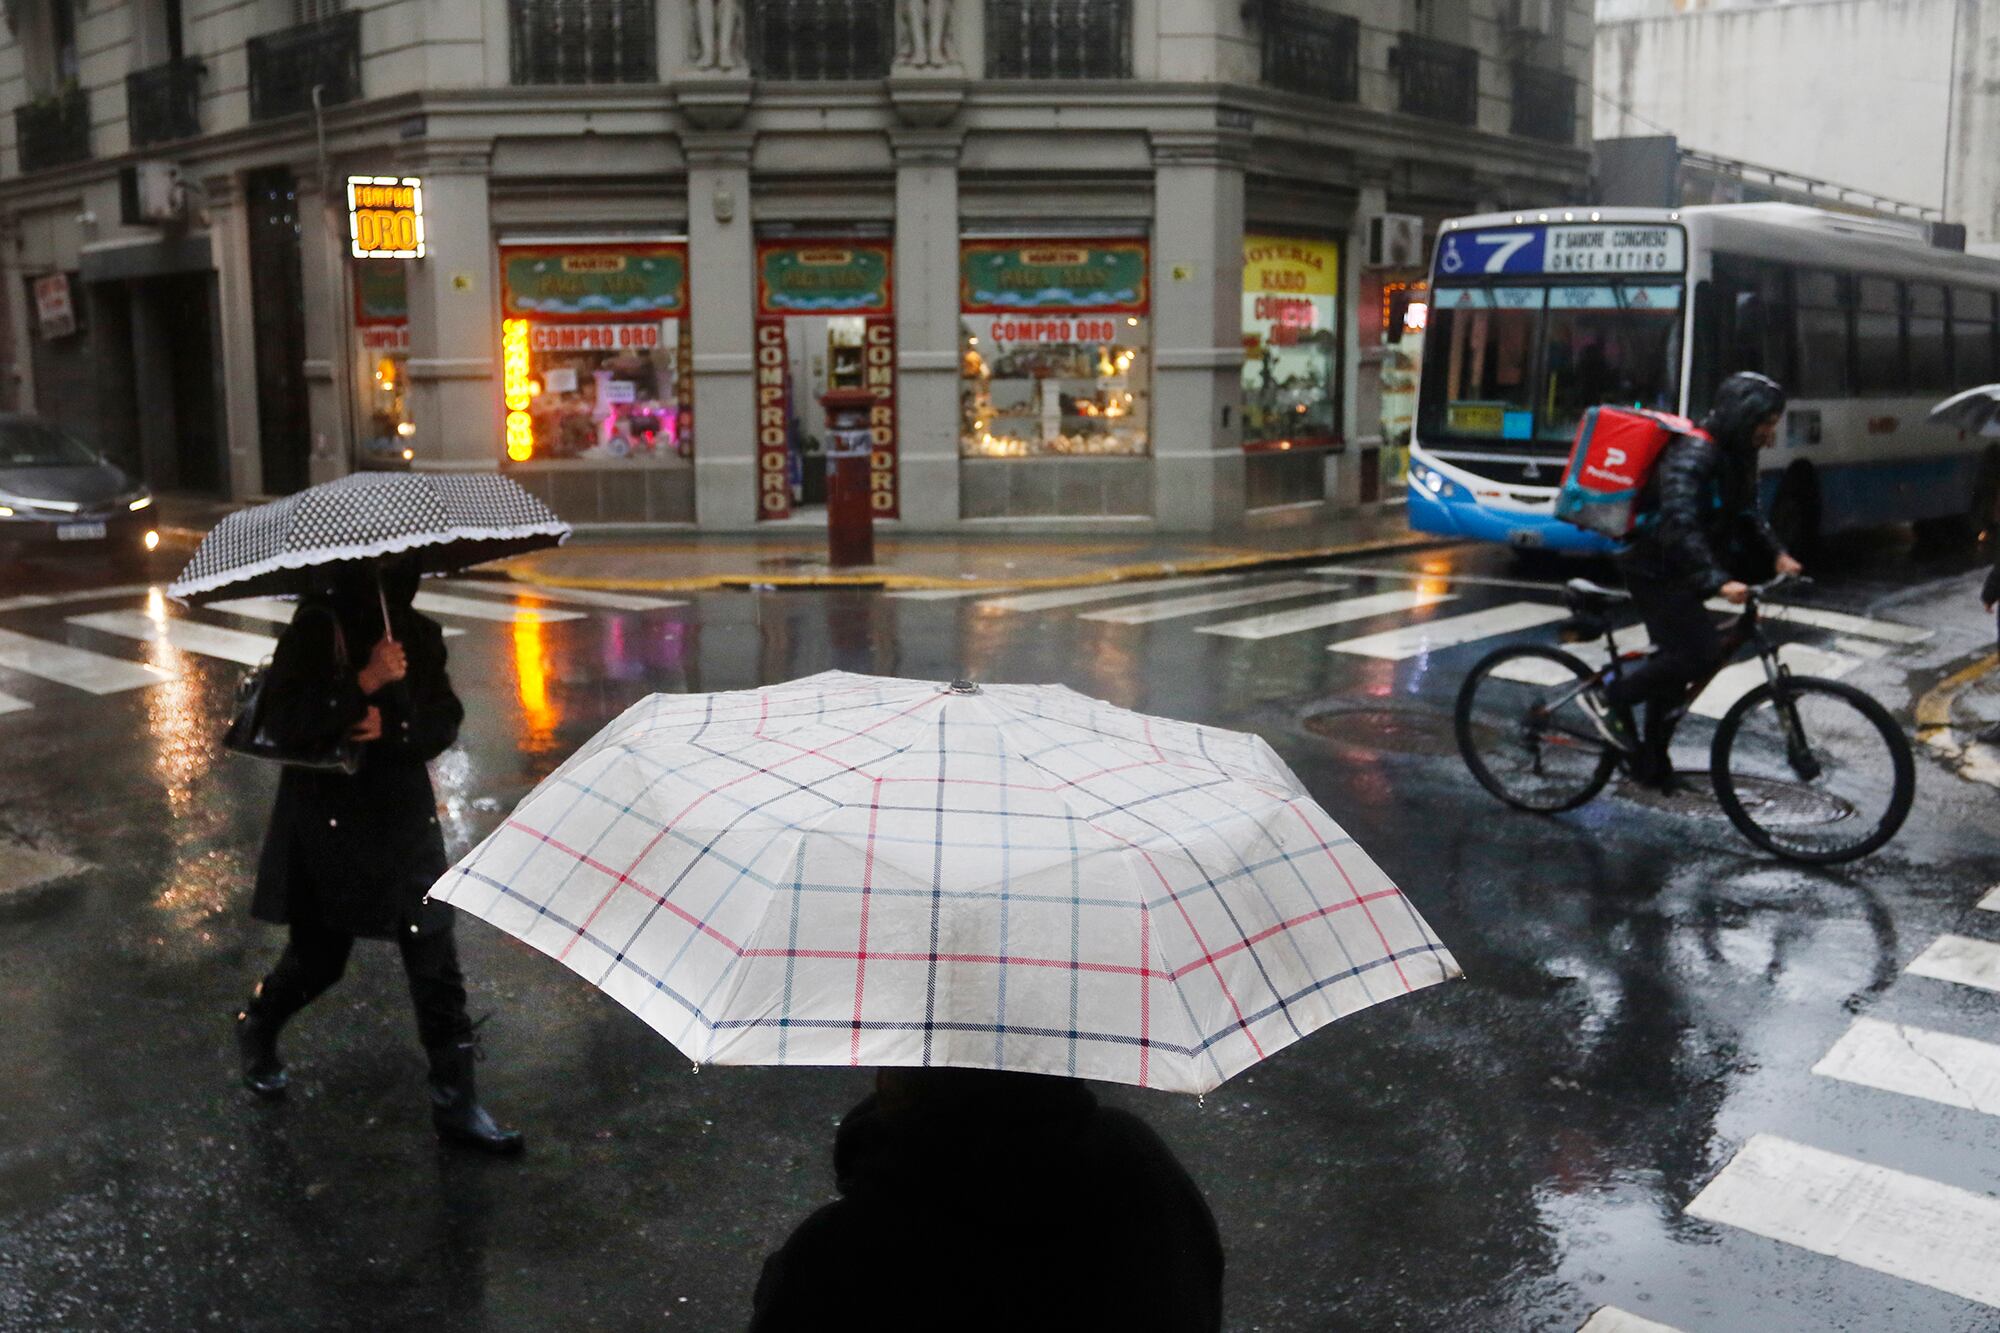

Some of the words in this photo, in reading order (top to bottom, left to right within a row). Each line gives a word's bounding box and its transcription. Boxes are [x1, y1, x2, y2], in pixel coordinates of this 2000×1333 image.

[355, 186, 414, 208] COMPRO
[357, 209, 417, 250] ORO
[1475, 233, 1534, 273] 7
[533, 327, 614, 348] COMPRO
[619, 327, 657, 346] ORO
[991, 321, 1071, 342] COMPRO
[1076, 321, 1114, 342] ORO
[759, 325, 786, 447] COMPRO
[762, 451, 787, 511] ORO
[870, 451, 894, 510] ORO
